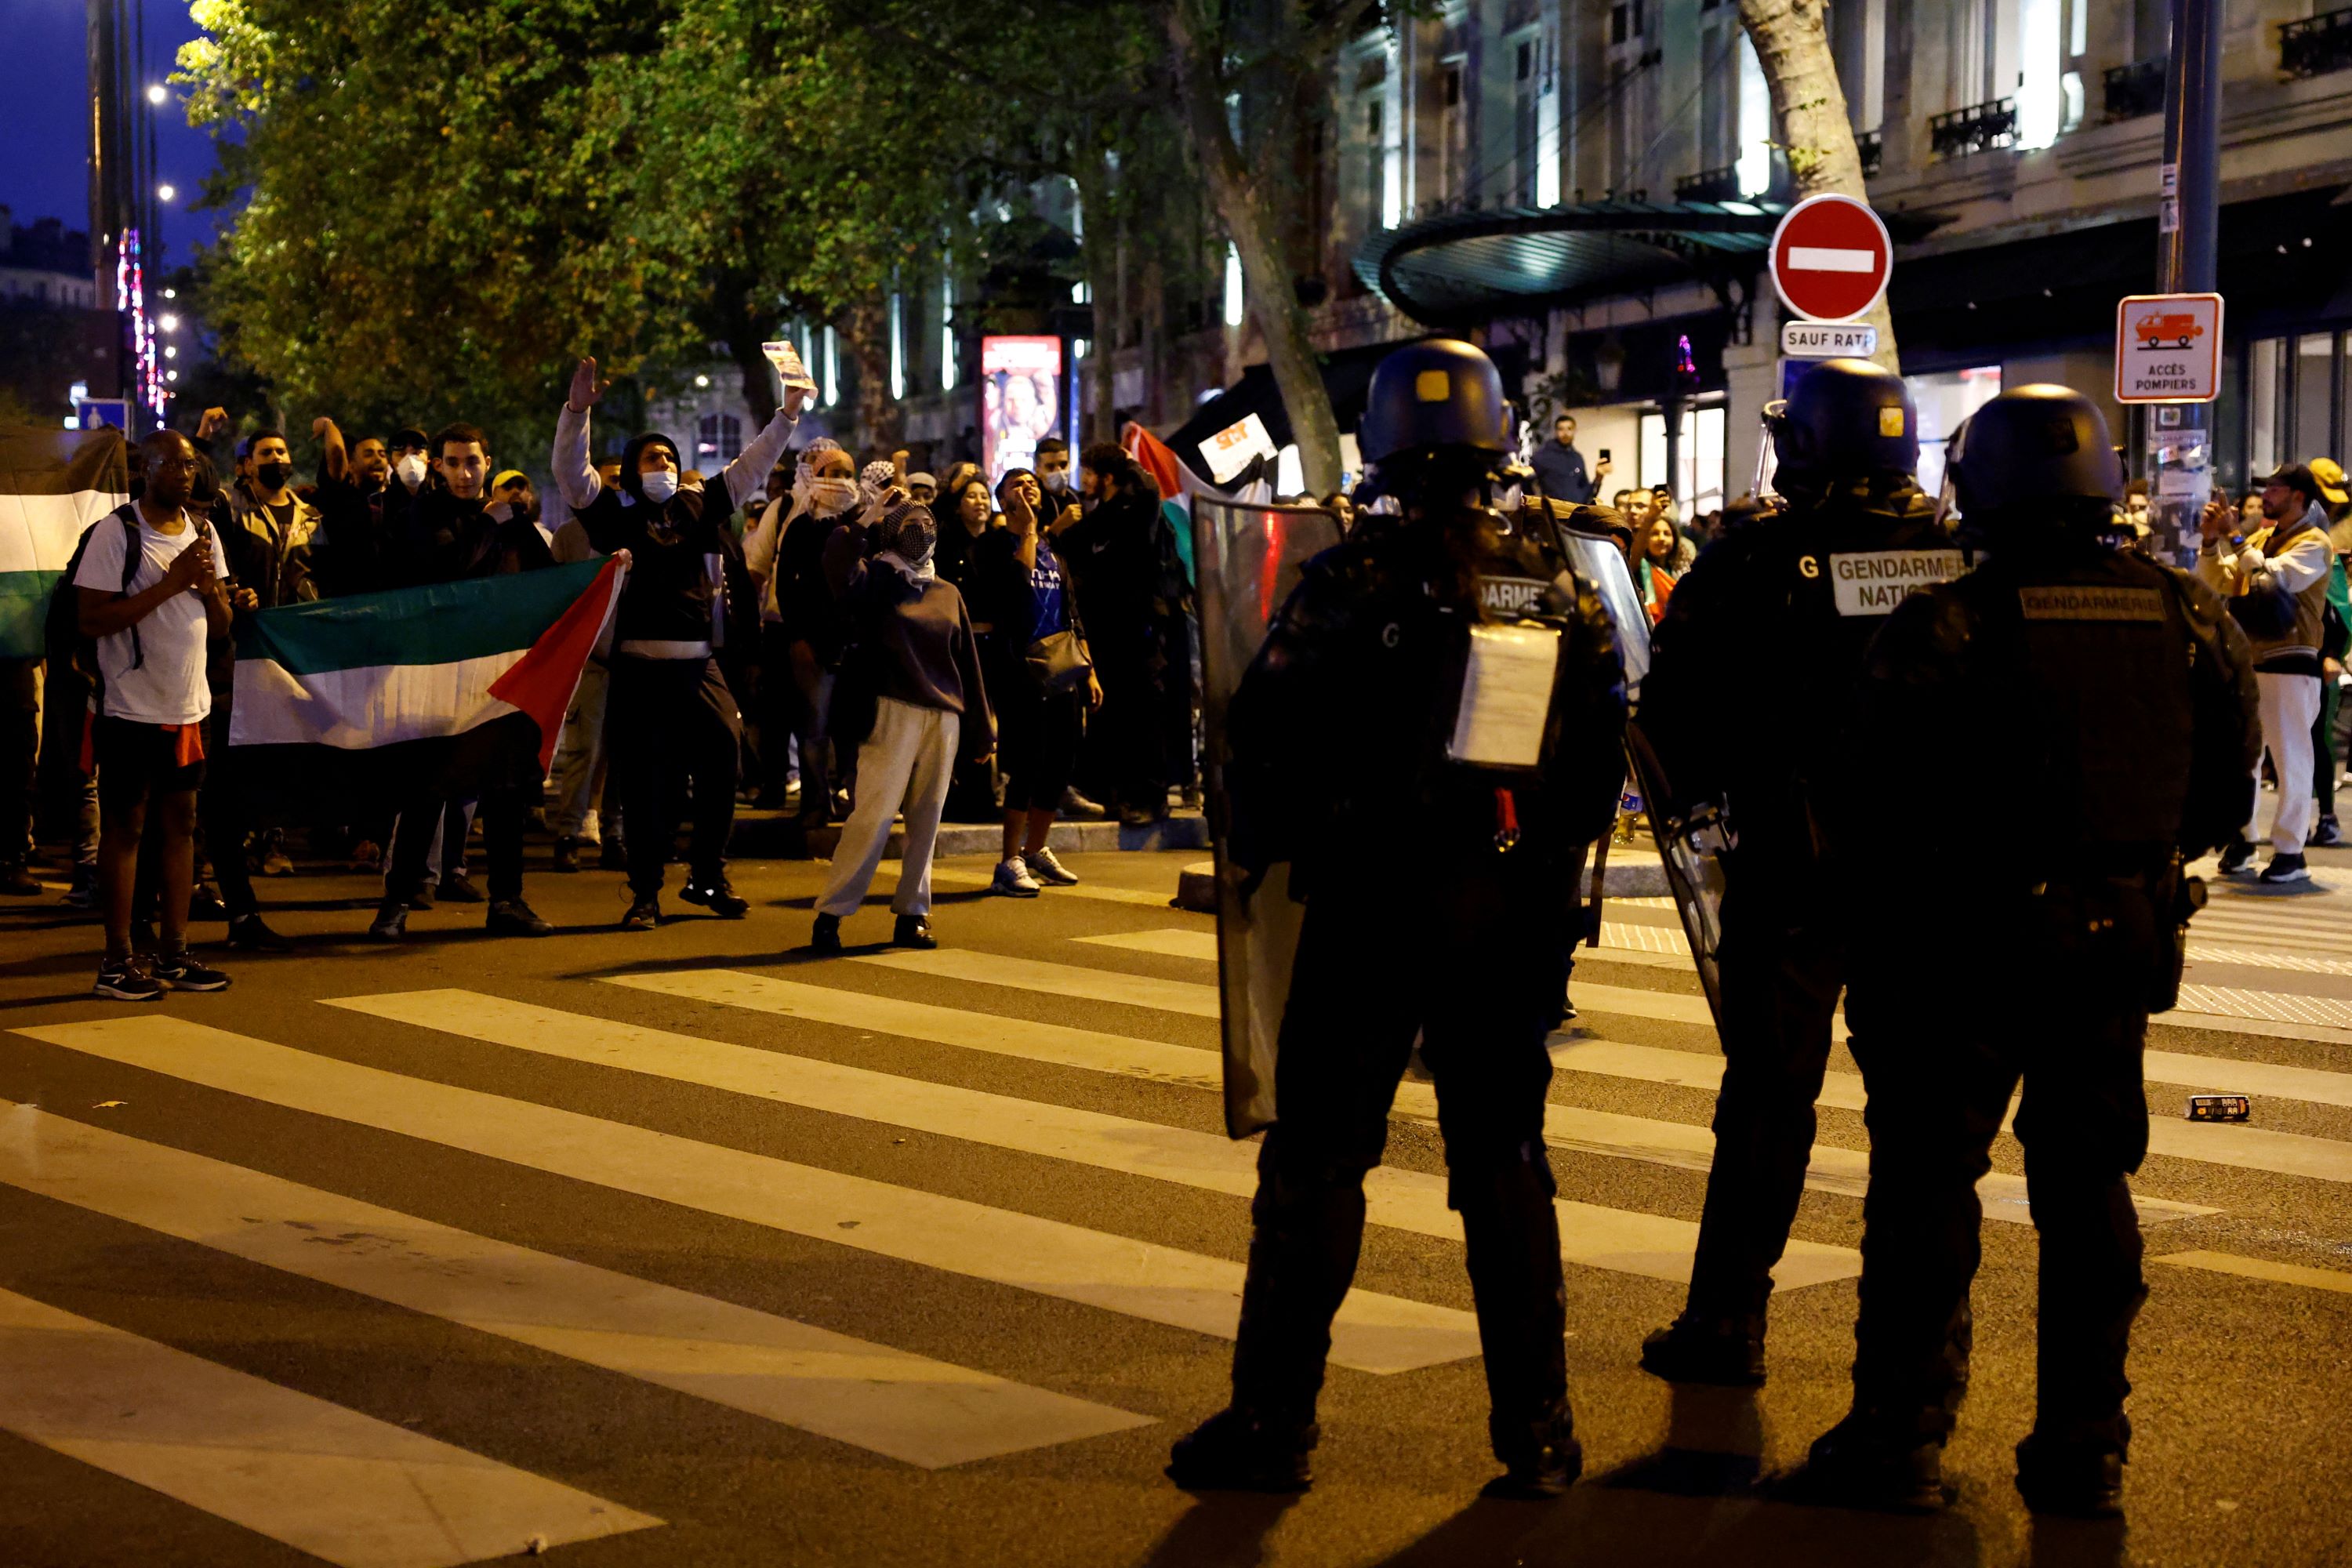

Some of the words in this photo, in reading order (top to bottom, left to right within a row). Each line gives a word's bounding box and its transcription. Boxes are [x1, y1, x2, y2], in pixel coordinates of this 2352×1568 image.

[1788, 332, 1828, 345] SAUF
[1835, 333, 1872, 347] RATP
[2136, 379, 2196, 390] POMPIERS
[1798, 554, 1820, 579] G
[2027, 595, 2159, 611] GENDARMERIE
[1382, 622, 1401, 649] G
